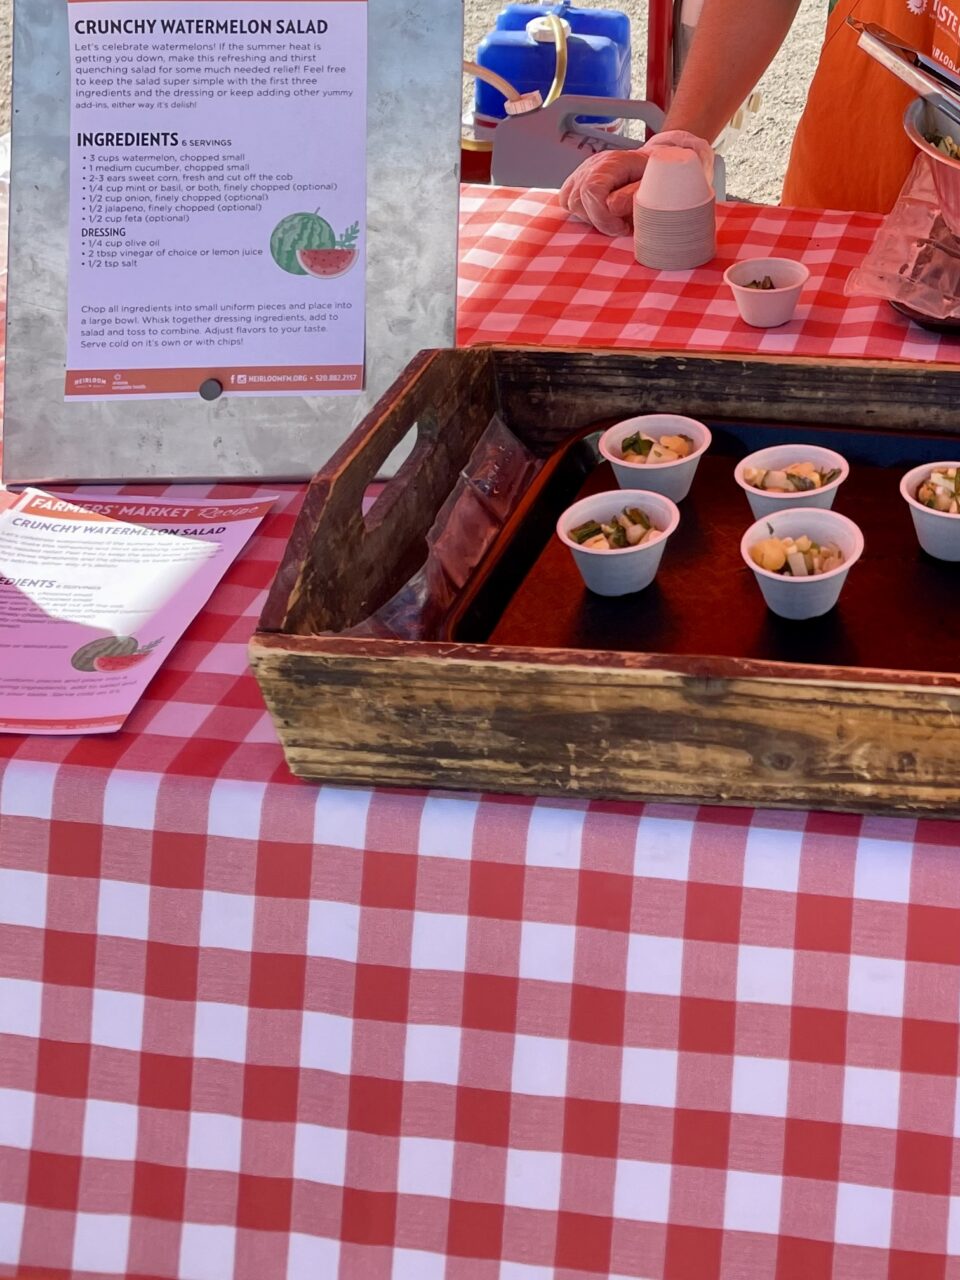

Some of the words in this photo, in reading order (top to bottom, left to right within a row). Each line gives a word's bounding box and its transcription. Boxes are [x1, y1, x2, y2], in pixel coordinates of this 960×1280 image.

[74, 18, 157, 35] CRUNCHY
[160, 18, 272, 35] WATERMELON
[275, 18, 329, 35] SALAD
[74, 42, 99, 51] Let's
[102, 42, 149, 51] celebrate
[152, 42, 216, 51] watermelons!
[228, 42, 244, 51] the
[288, 42, 311, 51] heat
[74, 54, 112, 65] getting
[114, 56, 134, 64] you
[136, 54, 166, 64] down,
[168, 54, 195, 62] make
[197, 54, 215, 62] this
[217, 54, 267, 64] refreshing
[269, 54, 288, 62] and
[290, 53, 316, 62] thirst
[75, 65, 128, 76] quenching
[130, 65, 156, 74] salad
[158, 65, 172, 74] for
[204, 65, 231, 74] much
[233, 65, 271, 74] needed
[273, 65, 301, 74] relief!
[303, 65, 324, 74] Feel
[326, 65, 346, 74] free
[89, 77, 114, 87] keep
[116, 77, 133, 85] the
[135, 77, 161, 85] salad
[163, 78, 190, 87] super
[192, 77, 224, 87] simple
[227, 77, 248, 85] with
[250, 77, 267, 85] the
[269, 76, 289, 85] first
[291, 76, 318, 85] three
[76, 132, 179, 147] INGREDIENTS
[181, 139, 188, 147] 6
[189, 138, 233, 147] SERVINGS
[97, 155, 120, 163] cups
[122, 153, 178, 163] watermelon,
[179, 153, 220, 163] chopped
[222, 152, 245, 161] small
[95, 163, 132, 172] medium
[134, 163, 182, 174] cucumber,
[184, 163, 225, 174] chopped
[226, 163, 250, 172] small
[89, 173, 104, 182] 2-3
[128, 173, 155, 181] sweet
[157, 175, 180, 183] corn,
[182, 173, 206, 181] fresh
[207, 173, 225, 181] and
[226, 173, 241, 181] cut
[243, 173, 256, 181] off
[258, 173, 274, 181] the
[275, 173, 293, 181] cob
[81, 227, 126, 238] DRESSING
[88, 238, 103, 247] 1/4
[105, 240, 123, 248] cup
[124, 238, 147, 246] olive
[148, 238, 160, 246] oil
[88, 259, 102, 267] 1/2
[104, 259, 120, 269] tsp
[121, 259, 138, 267] salt
[80, 304, 106, 314] Chop
[108, 304, 119, 312] all
[121, 303, 172, 313] ingredients
[174, 303, 192, 311] into
[194, 303, 218, 311] small
[220, 302, 255, 310] uniform
[257, 302, 286, 312] pieces
[288, 302, 306, 310] and
[308, 301, 332, 311] place
[334, 301, 352, 309] into
[80, 339, 107, 347] Serve
[109, 339, 129, 347] cold
[145, 338, 159, 347] it's
[195, 338, 215, 346] with
[217, 337, 244, 347] chips!
[74, 377, 107, 386] HEIRLOOM
[118, 506, 194, 518] MARKET
[198, 505, 260, 519] Recipe
[12, 517, 82, 533] CRUNCHY
[83, 525, 180, 536] WATERMELON
[180, 526, 227, 536] SALAD
